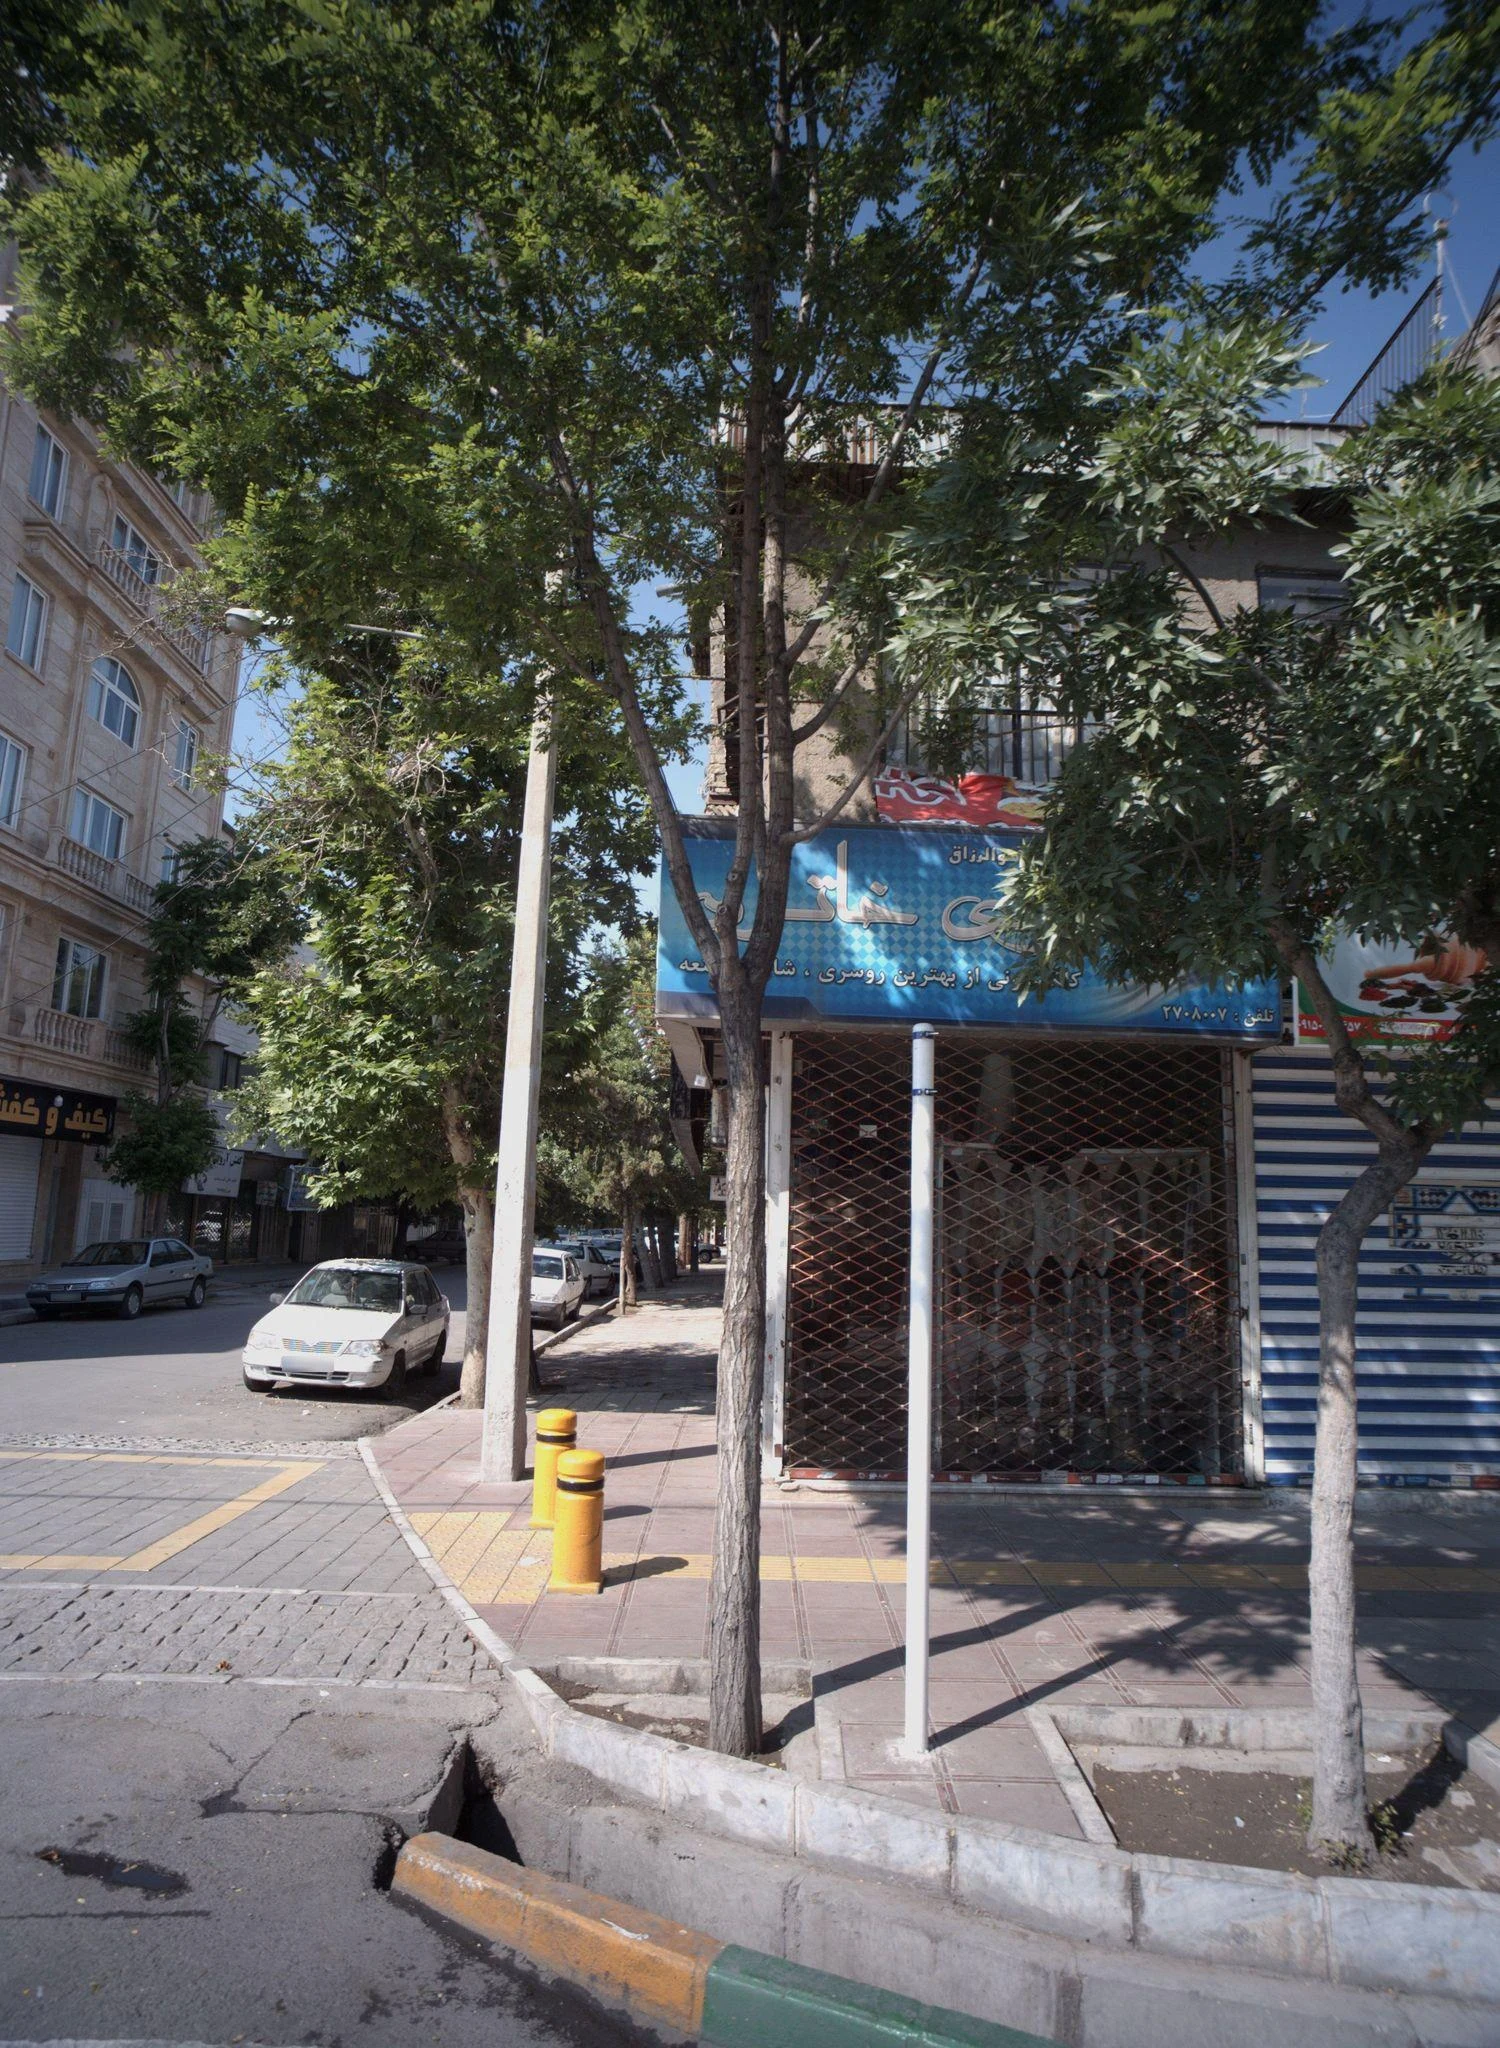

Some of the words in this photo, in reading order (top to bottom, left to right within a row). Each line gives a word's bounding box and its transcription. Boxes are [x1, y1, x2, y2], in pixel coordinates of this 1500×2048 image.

[818, 965, 886, 987] روسری
[893, 965, 957, 989] بهترین
[966, 967, 982, 988] از
[1243, 1006, 1274, 1028] تلفن
[45, 1106, 59, 1136] و
[64, 1101, 108, 1139] کیف
